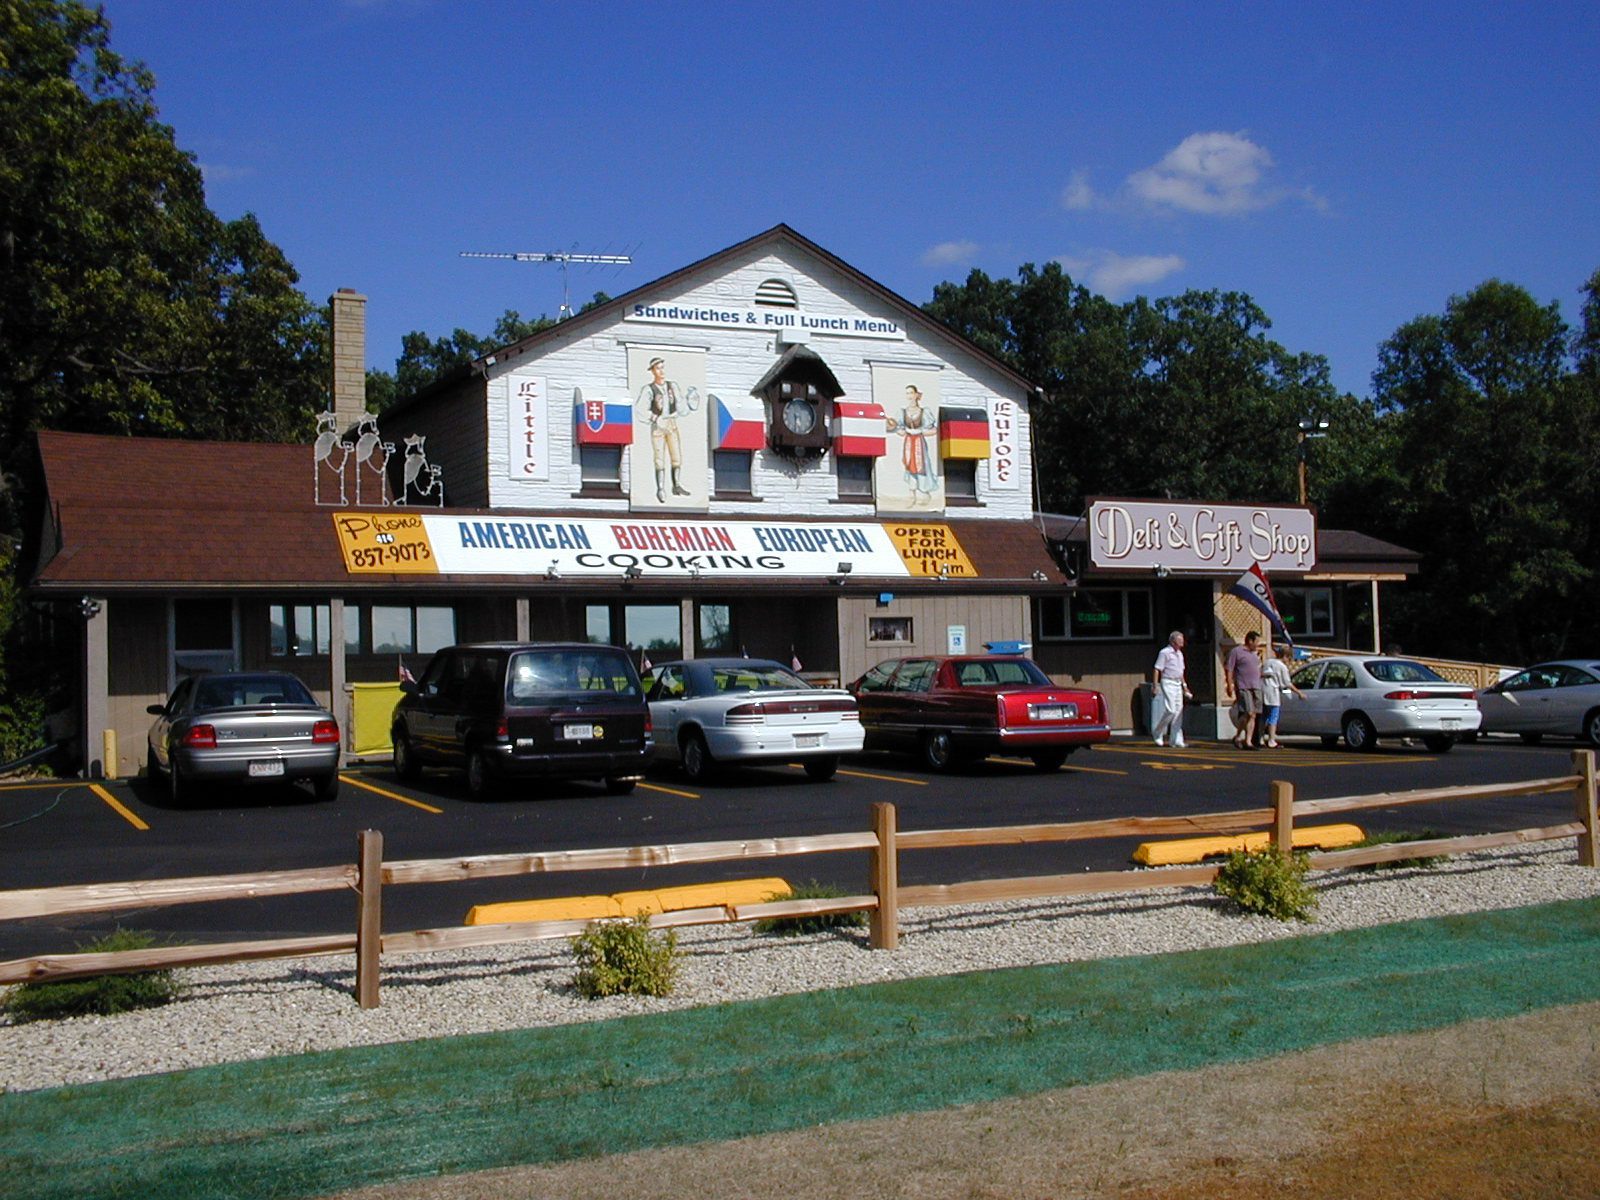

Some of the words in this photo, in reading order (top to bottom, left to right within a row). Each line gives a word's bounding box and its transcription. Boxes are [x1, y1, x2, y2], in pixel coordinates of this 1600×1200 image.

[634, 304, 740, 323] Sandwiches
[746, 312, 757, 324] &
[764, 313, 794, 326] Full
[801, 316, 848, 330] Lunch
[854, 319, 897, 333] Menu
[518, 382, 538, 473] Little
[994, 402, 1012, 482] Europe
[339, 515, 421, 540] Phone
[458, 521, 592, 550] AMERICAN
[610, 524, 737, 551] BOHEMIAN
[752, 527, 874, 553] EUROPEAN
[894, 527, 945, 537] OPEN
[1095, 506, 1162, 559] Deli
[1166, 512, 1191, 550] &
[1191, 509, 1242, 567] Gift
[1249, 510, 1311, 568] Shop
[351, 541, 430, 567] 857-9073
[902, 548, 957, 560] LUNCH
[908, 538, 946, 548] FOR
[575, 553, 785, 569] COOKING
